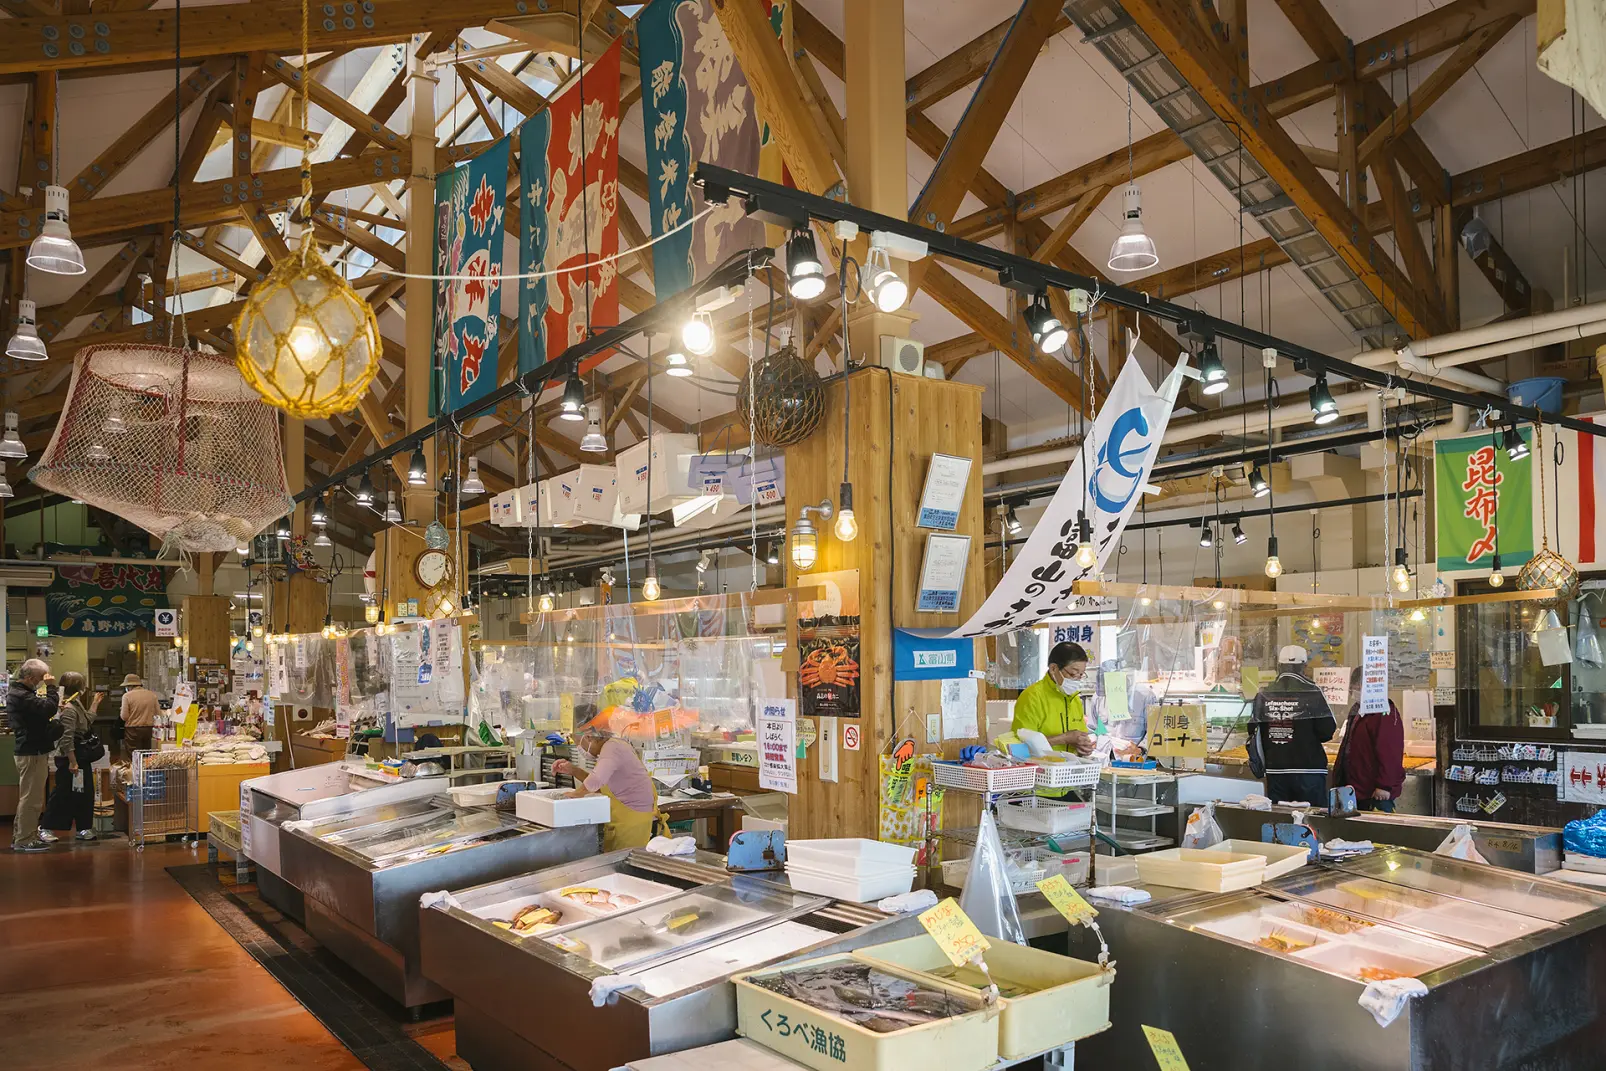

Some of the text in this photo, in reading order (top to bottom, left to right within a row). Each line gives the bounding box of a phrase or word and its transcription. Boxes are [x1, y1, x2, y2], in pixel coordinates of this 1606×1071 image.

[1054, 625, 1094, 643] お刺身
[764, 706, 786, 717] お知らせ
[766, 722, 783, 730] 本日より
[1163, 715, 1190, 730] 刺身
[1153, 733, 1203, 747] コーナー
[760, 1008, 846, 1063] くろべ漁協
